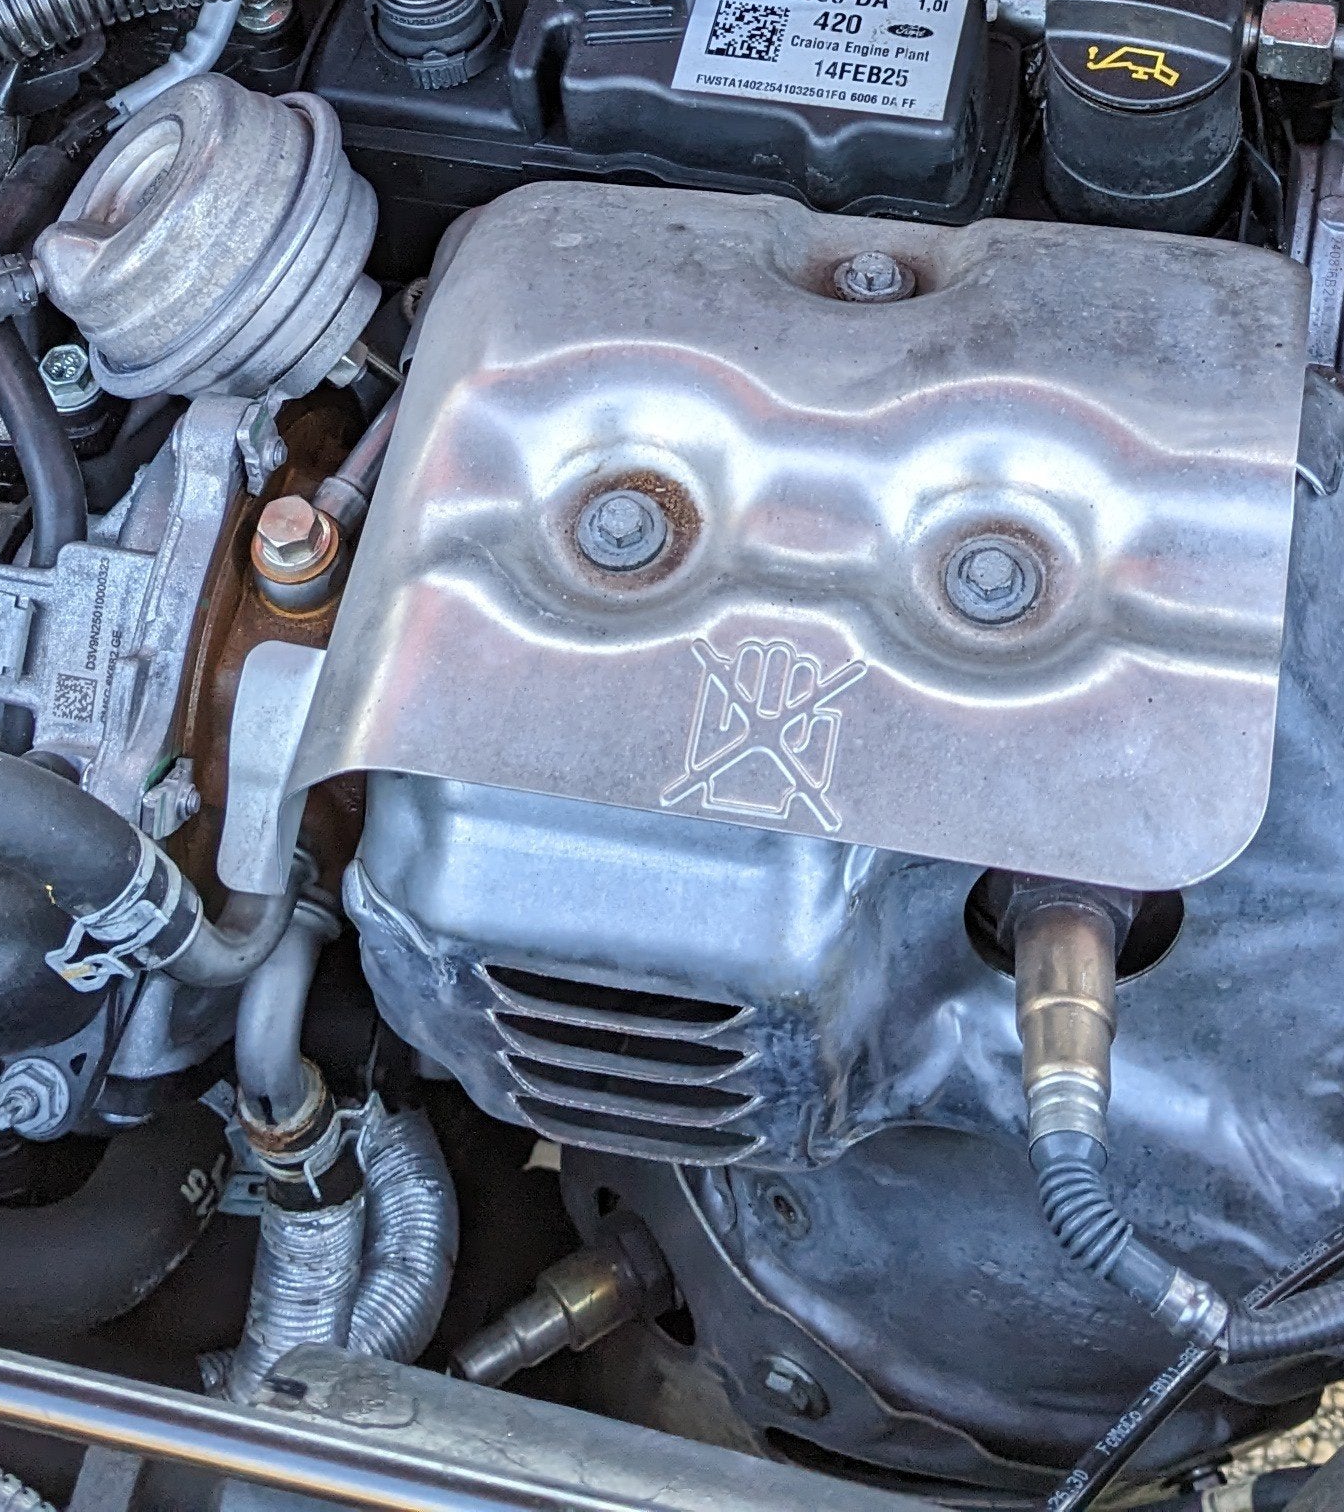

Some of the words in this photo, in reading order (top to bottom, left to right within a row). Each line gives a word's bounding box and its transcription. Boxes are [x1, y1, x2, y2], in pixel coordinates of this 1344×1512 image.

[813, 11, 863, 35] 420
[790, 34, 841, 53] Craiova
[845, 40, 890, 59] Engine
[895, 47, 930, 63] Plant
[814, 59, 909, 88] 14FEB25
[850, 91, 878, 105] 6006
[881, 94, 899, 107] DA
[901, 97, 917, 110] FF
[111, 629, 122, 648] GE
